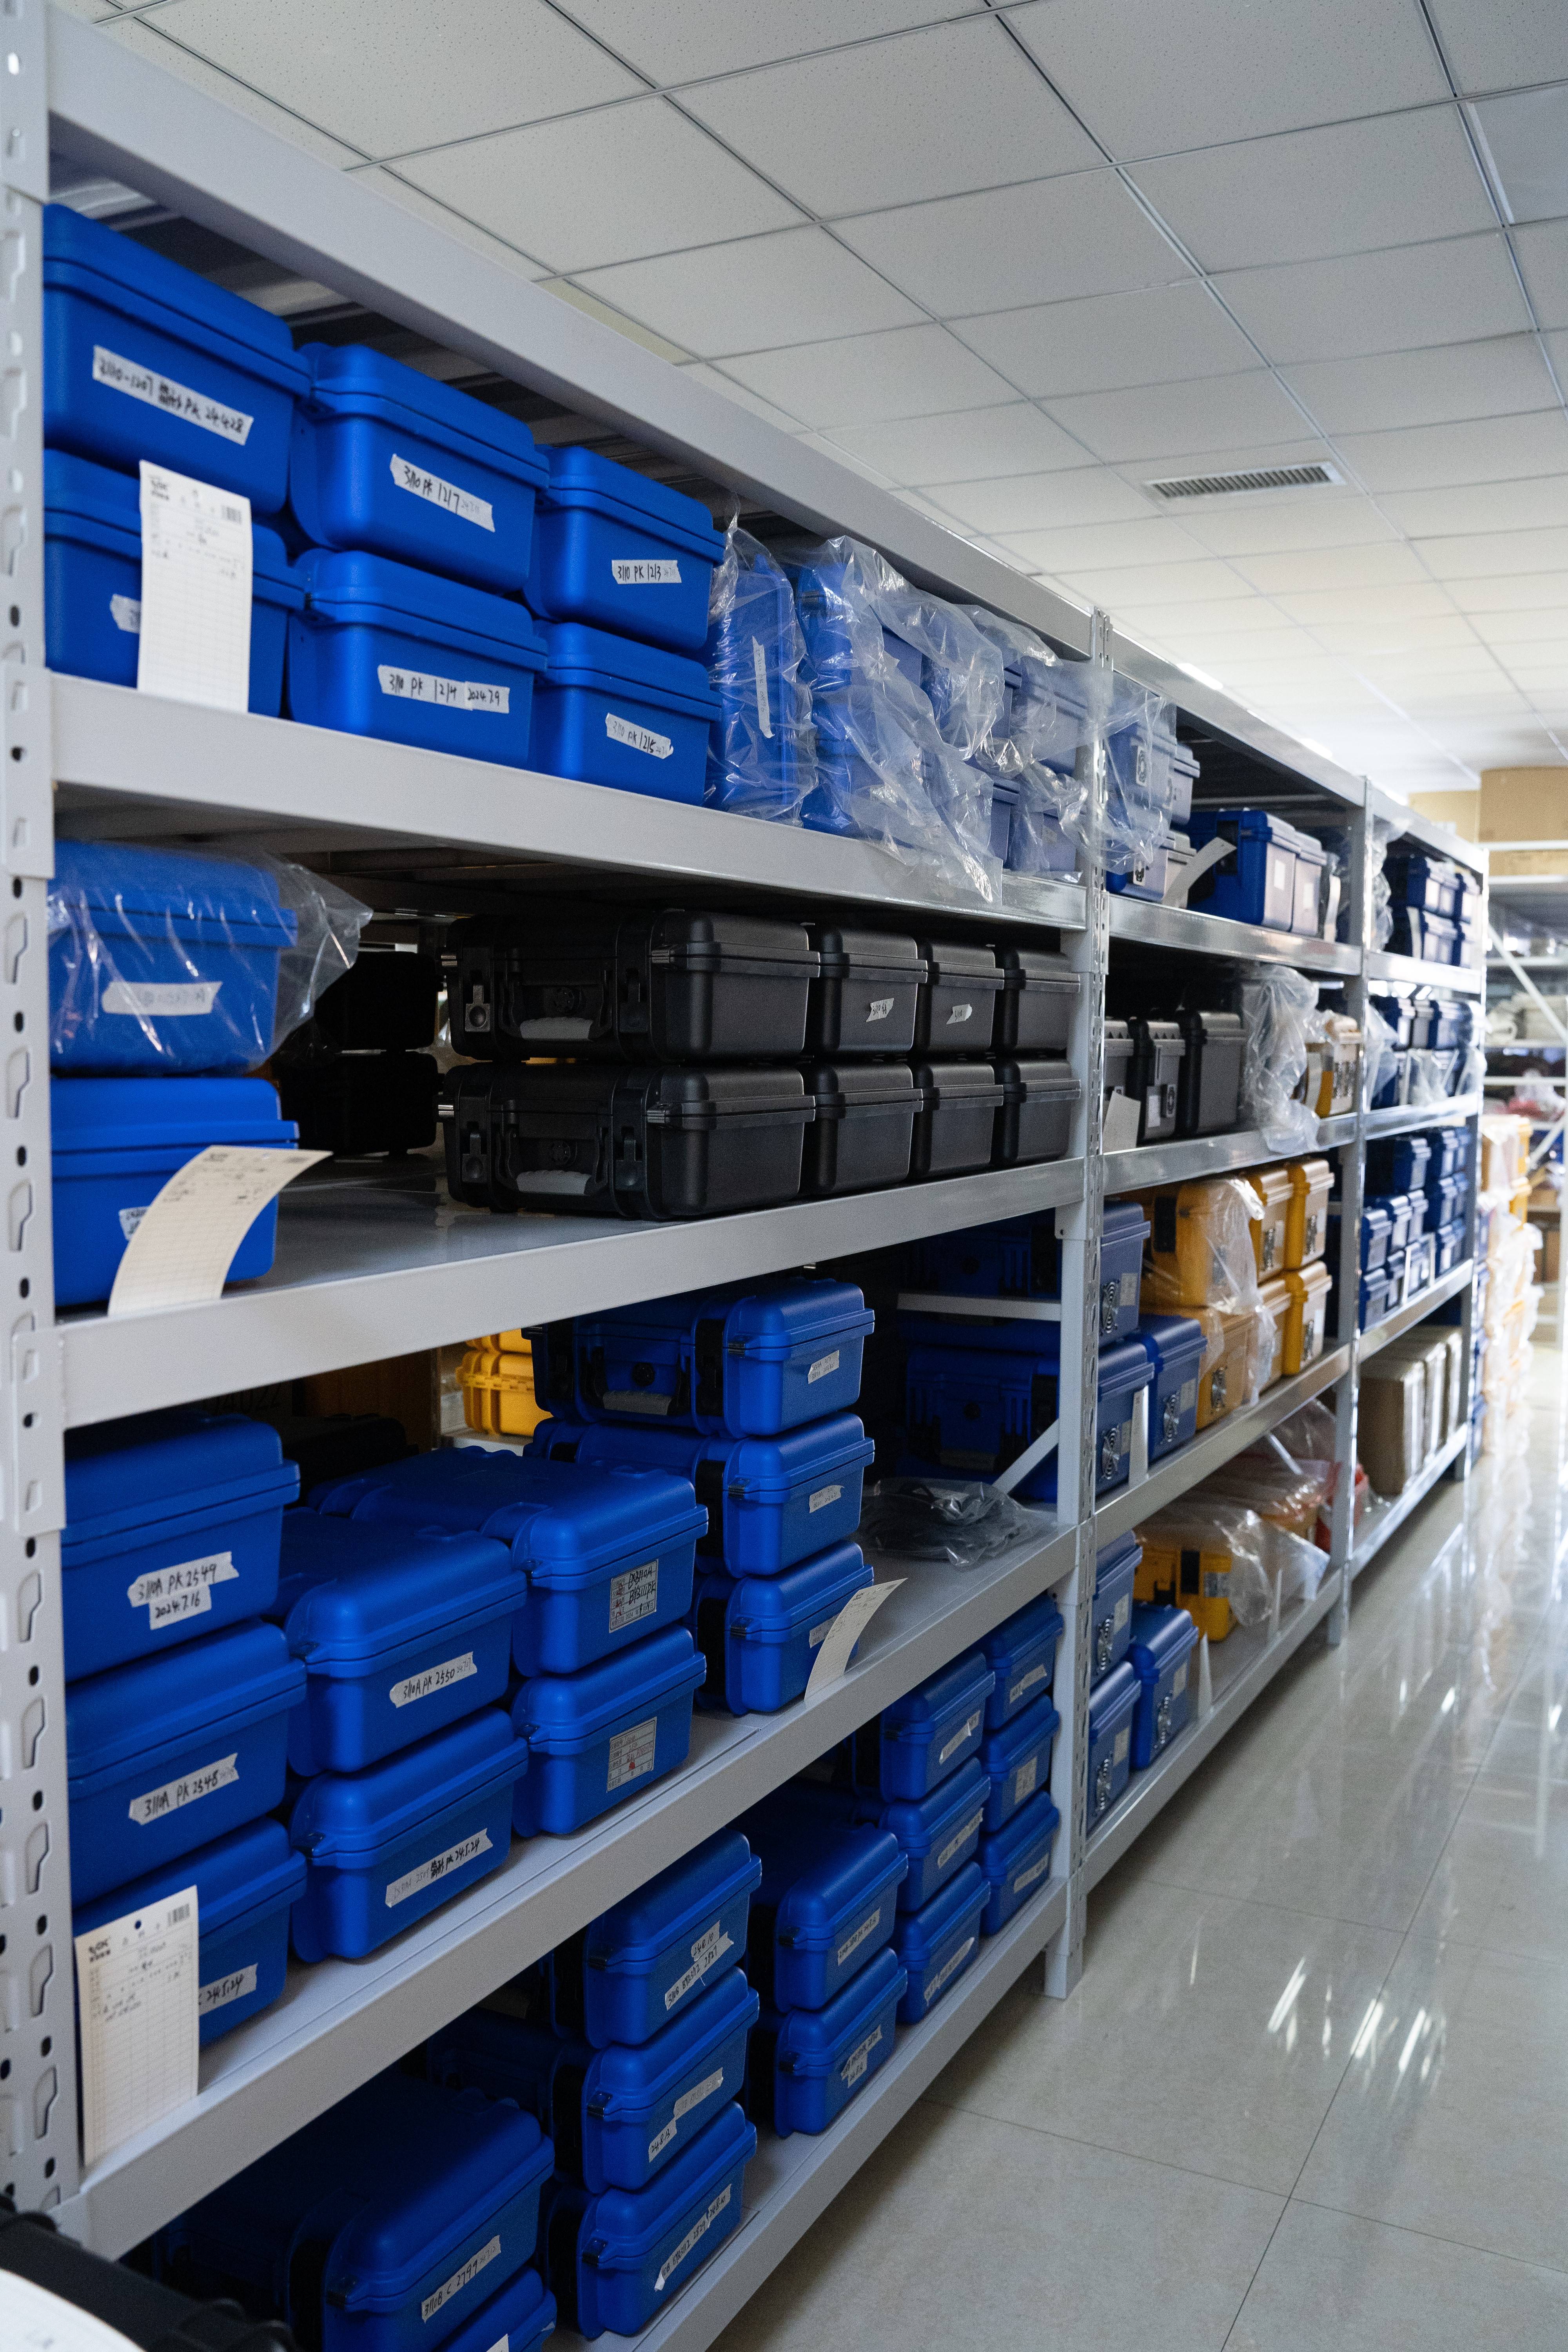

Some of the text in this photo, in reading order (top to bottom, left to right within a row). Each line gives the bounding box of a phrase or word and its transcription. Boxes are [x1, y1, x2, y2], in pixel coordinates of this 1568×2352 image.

[617, 565, 630, 582] 3110
[634, 565, 644, 582] PK
[647, 563, 661, 582] 1213
[639, 732, 656, 753] 1215
[436, 1668, 455, 1686] 2550
